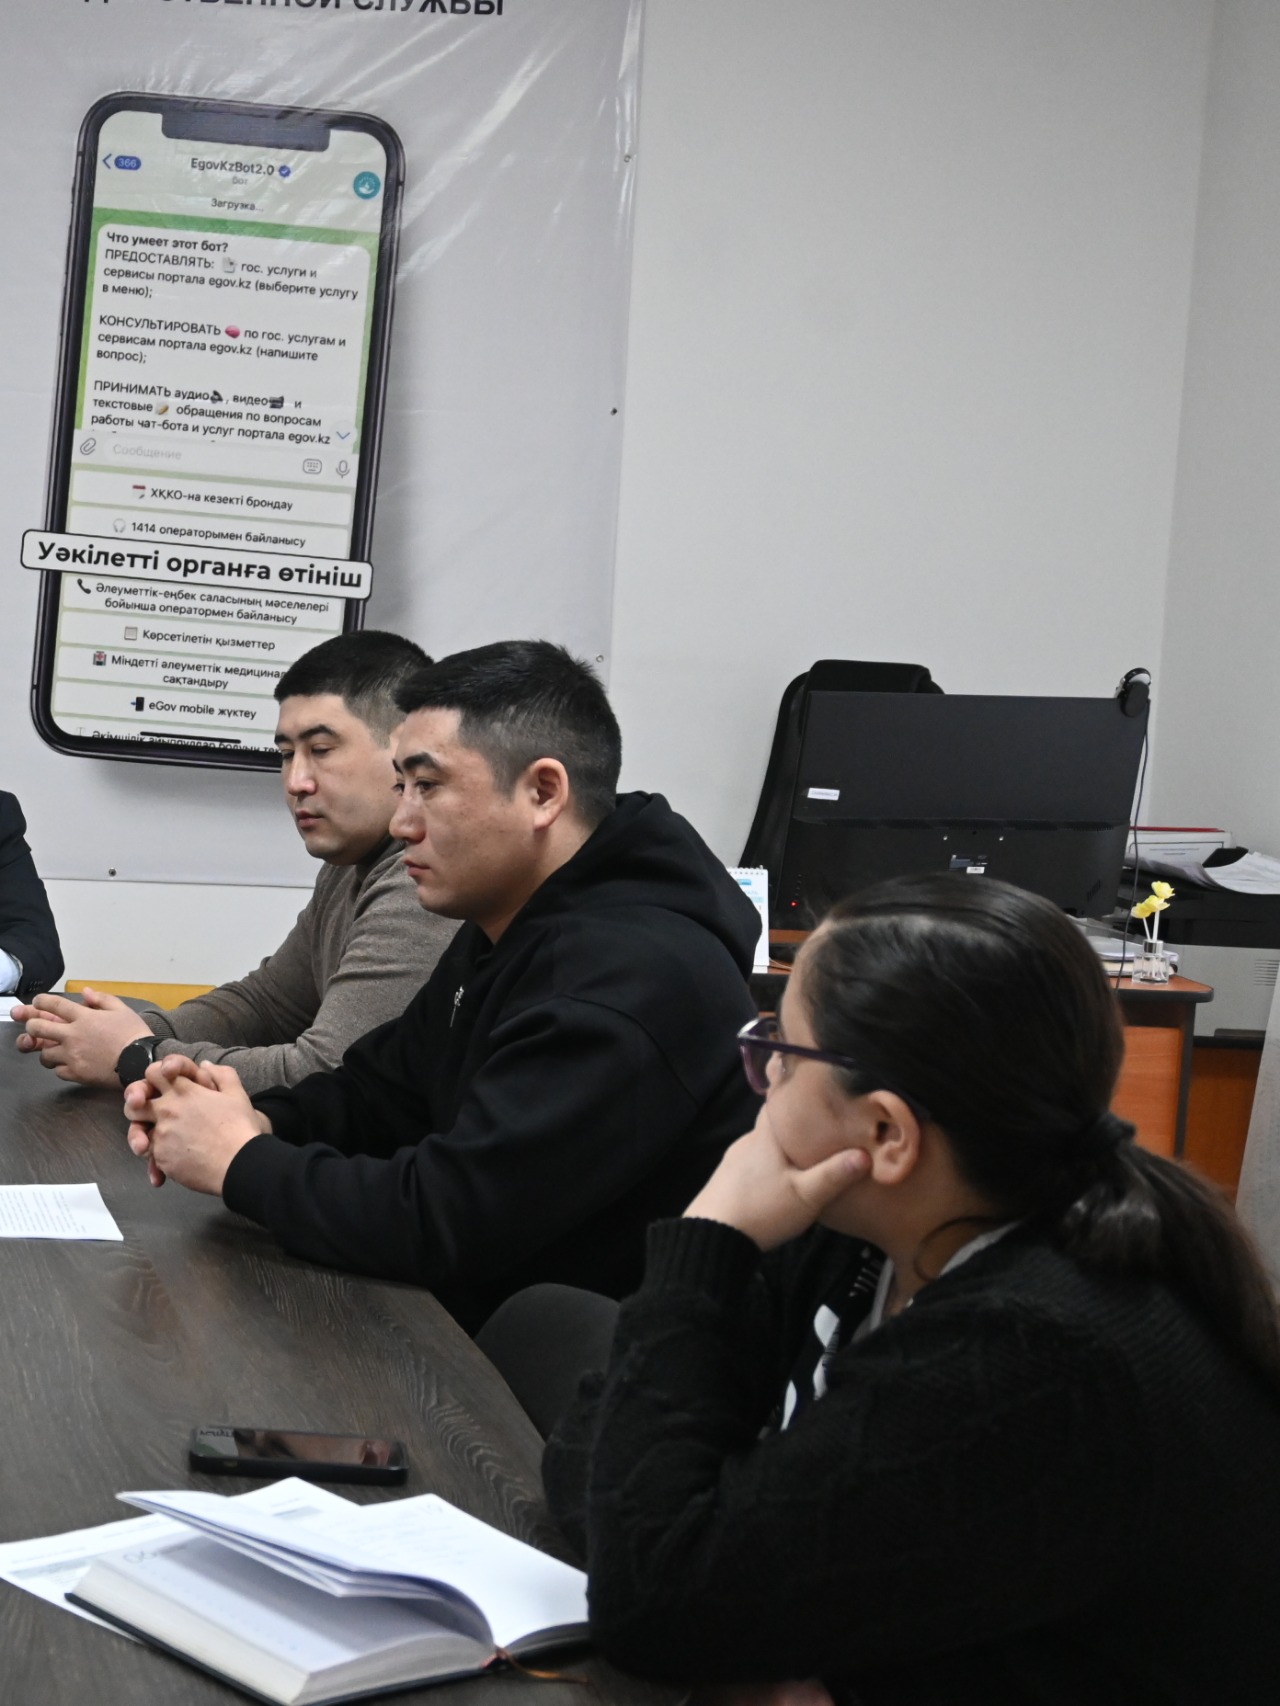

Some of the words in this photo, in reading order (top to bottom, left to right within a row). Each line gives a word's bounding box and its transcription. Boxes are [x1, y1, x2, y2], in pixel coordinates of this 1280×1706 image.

[190, 157, 275, 176] EgovKzBot2.0
[107, 232, 129, 244] Что
[132, 236, 169, 249] умеет
[172, 240, 198, 250] этот
[200, 240, 228, 252] бот?
[105, 248, 215, 269] ПРЕДОСТАВЛЯТЬ:
[241, 263, 263, 274] гос.
[267, 266, 307, 280] услуги
[310, 269, 317, 277] и
[102, 284, 109, 293] в
[111, 284, 153, 299] меню);
[104, 268, 155, 282] сервисы
[158, 272, 205, 286] портала
[209, 277, 251, 290] egov.kz
[255, 280, 316, 297] (выберите
[320, 287, 359, 301] услугу
[99, 314, 222, 336] КОНСУЛЬТИРОВАТЬ
[244, 329, 259, 340] по
[262, 330, 284, 342] гос.
[288, 333, 336, 347] услугам
[339, 338, 346, 347] и
[96, 349, 148, 364] вопрос);
[98, 332, 156, 347] сервисам
[158, 338, 207, 352] портала
[209, 342, 253, 356] egov.kz
[256, 345, 319, 361] (напишите
[94, 380, 172, 397] ПРИНИМАТЬ
[174, 389, 210, 402] аудио
[233, 394, 269, 406] видео
[294, 400, 302, 409] и
[93, 398, 153, 412] текстовые
[176, 405, 243, 420] обращения
[246, 412, 260, 422] по
[263, 414, 322, 428] вопросам
[91, 414, 134, 427] работы
[137, 416, 189, 432] чат-бота
[192, 424, 199, 432] и
[202, 425, 234, 438] услуг
[237, 427, 285, 442] портала
[288, 431, 331, 446] egov.kz
[204, 494, 245, 506] кезекті
[246, 496, 293, 510] брондау
[131, 522, 156, 534] 1414
[245, 531, 306, 548] байланысу
[37, 541, 160, 571] Уәкілетті
[166, 554, 271, 582] органға
[278, 564, 362, 588] өтініш
[105, 598, 156, 612] бойынша
[159, 604, 234, 620] оператормен
[236, 609, 298, 625] байланысу
[200, 593, 263, 608] саласының
[265, 599, 330, 613] мәселелері
[143, 629, 213, 644] Көрсетілетін
[215, 637, 276, 651] қызметтер
[111, 655, 159, 669] Міндетті
[161, 660, 222, 674] әлеуметтік
[162, 674, 229, 689] сақтандыру
[149, 701, 177, 712] eGov
[179, 704, 215, 715] mobile
[218, 707, 257, 720] жүктеу
